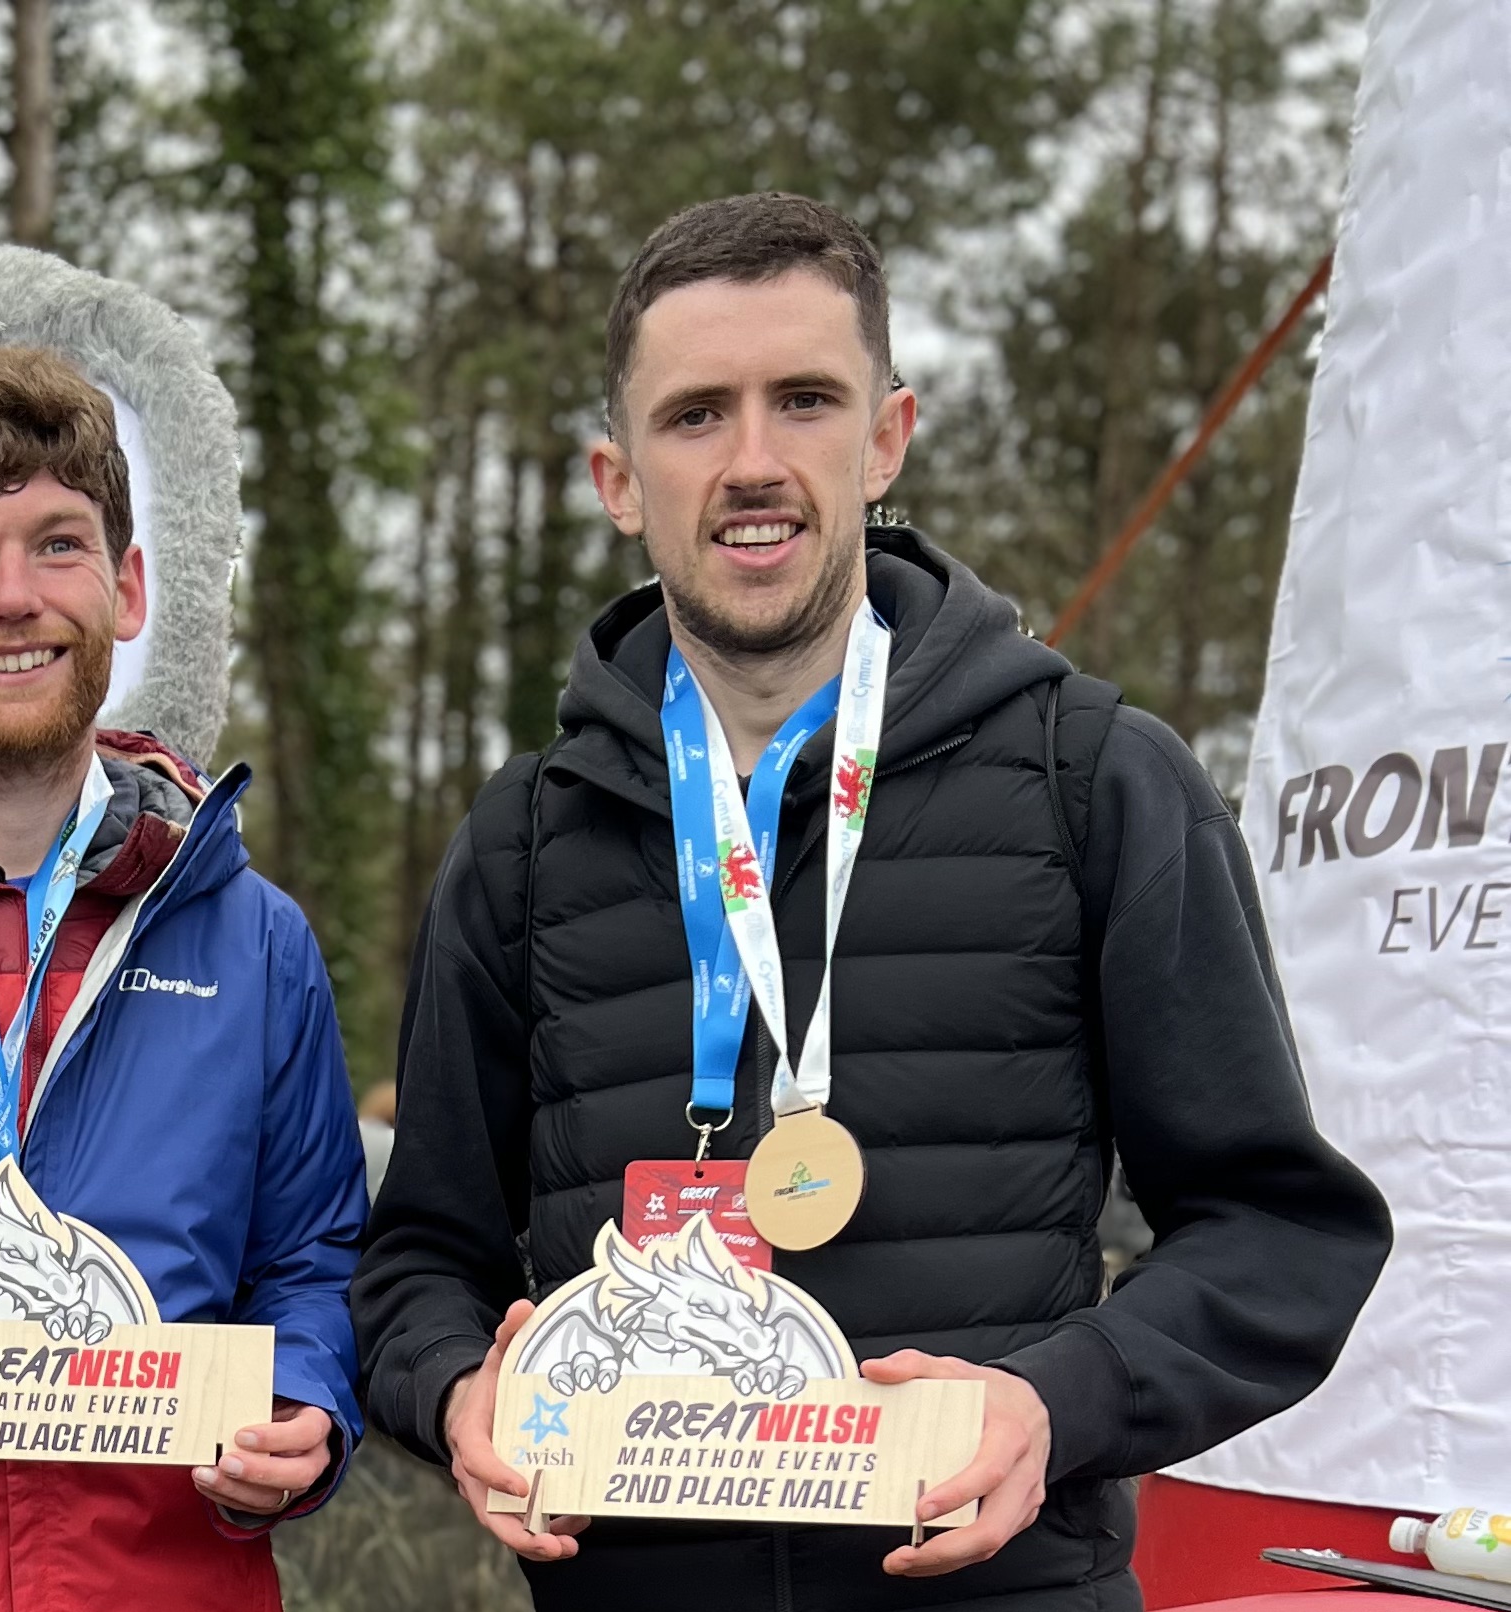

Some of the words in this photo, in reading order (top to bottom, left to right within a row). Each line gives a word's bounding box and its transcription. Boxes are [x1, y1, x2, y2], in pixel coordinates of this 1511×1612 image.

[712, 779, 734, 836] Cymru
[1269, 741, 1511, 874] FRON
[30, 907, 58, 967] GREAT
[150, 975, 219, 998] berghaus
[679, 1186, 720, 1200] GREAT
[87, 1393, 179, 1417] EVENTS
[90, 1423, 174, 1456] MALE
[512, 1445, 575, 1467] 2wish
[616, 1446, 764, 1471] MARATHON
[776, 1450, 879, 1474] EVENTS
[604, 1473, 671, 1505] 2ND
[677, 1475, 773, 1509] PLACE
[778, 1478, 871, 1512] MALE
